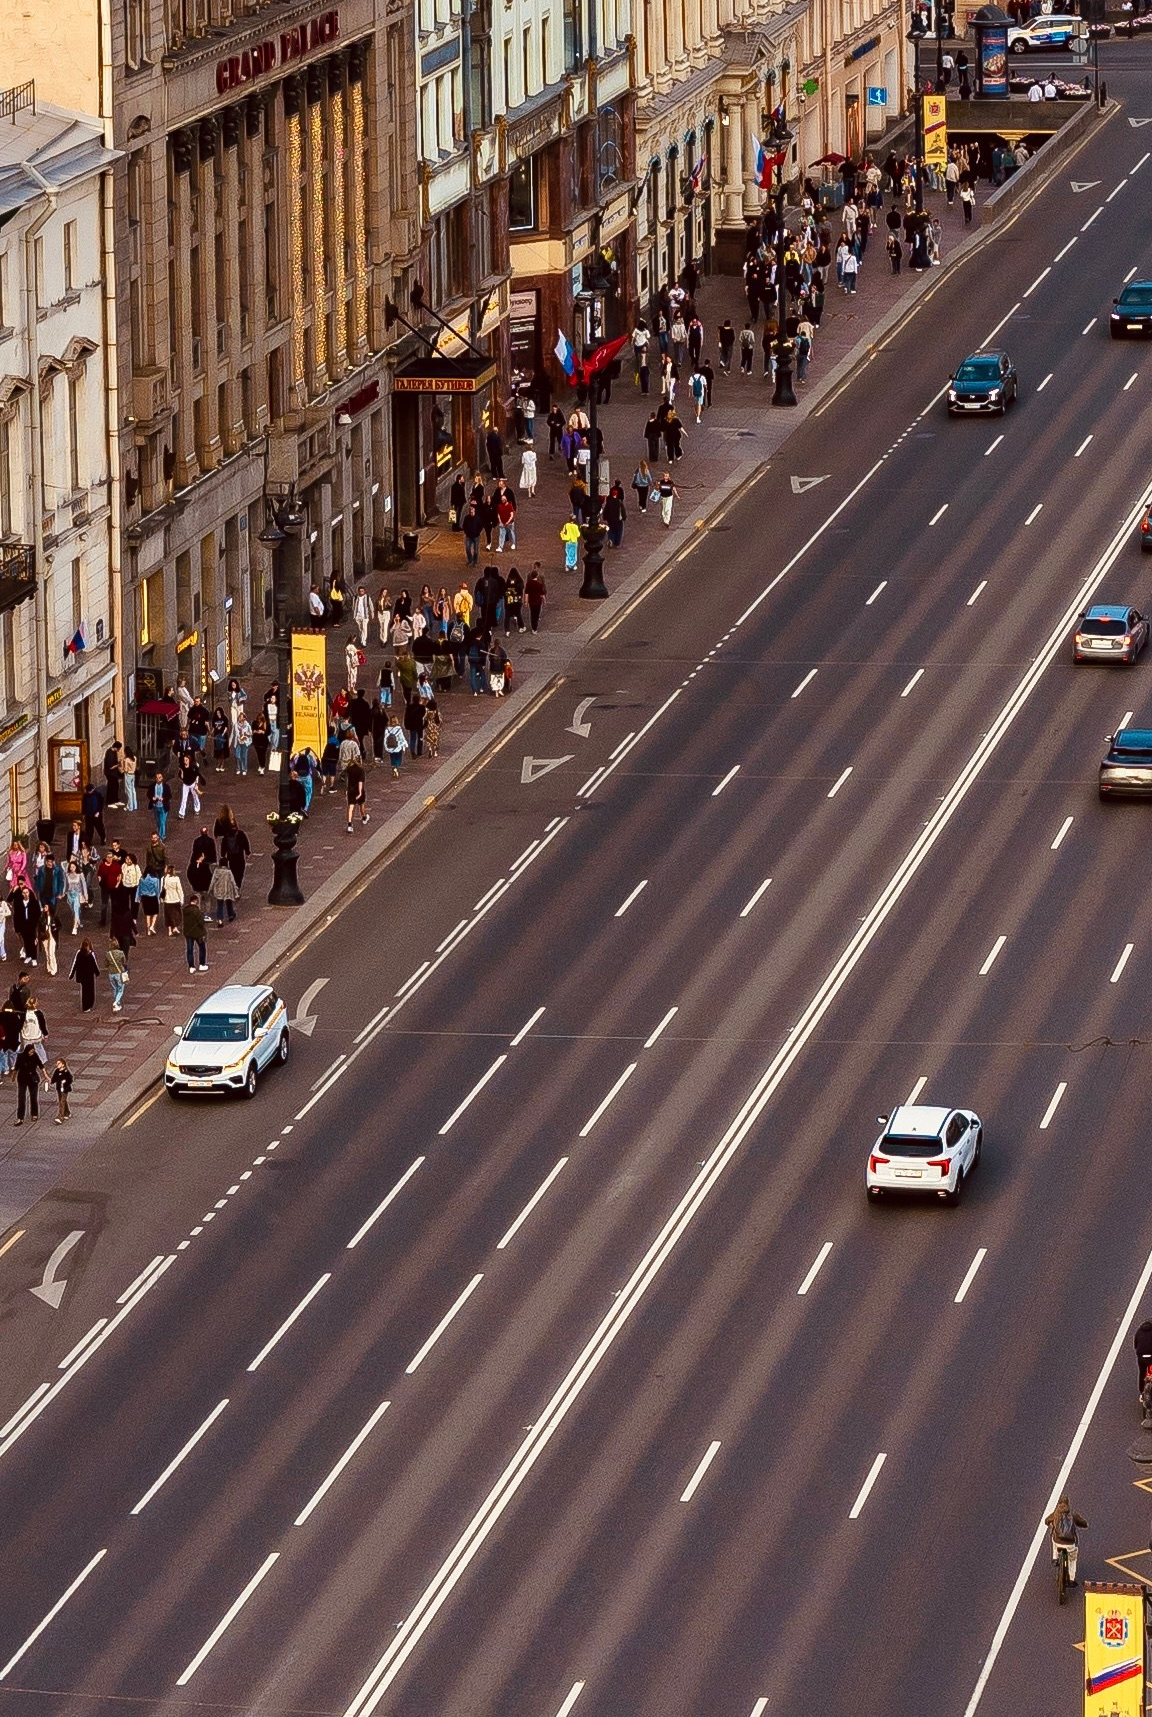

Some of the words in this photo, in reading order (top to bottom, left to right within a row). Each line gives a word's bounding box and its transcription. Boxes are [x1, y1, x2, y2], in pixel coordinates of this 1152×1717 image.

[216, 40, 276, 94] GRAND
[280, 10, 338, 64] PALACE
[396, 379, 433, 390] ГАЛЕРЕЯ
[435, 379, 474, 390] БУТИКОВ
